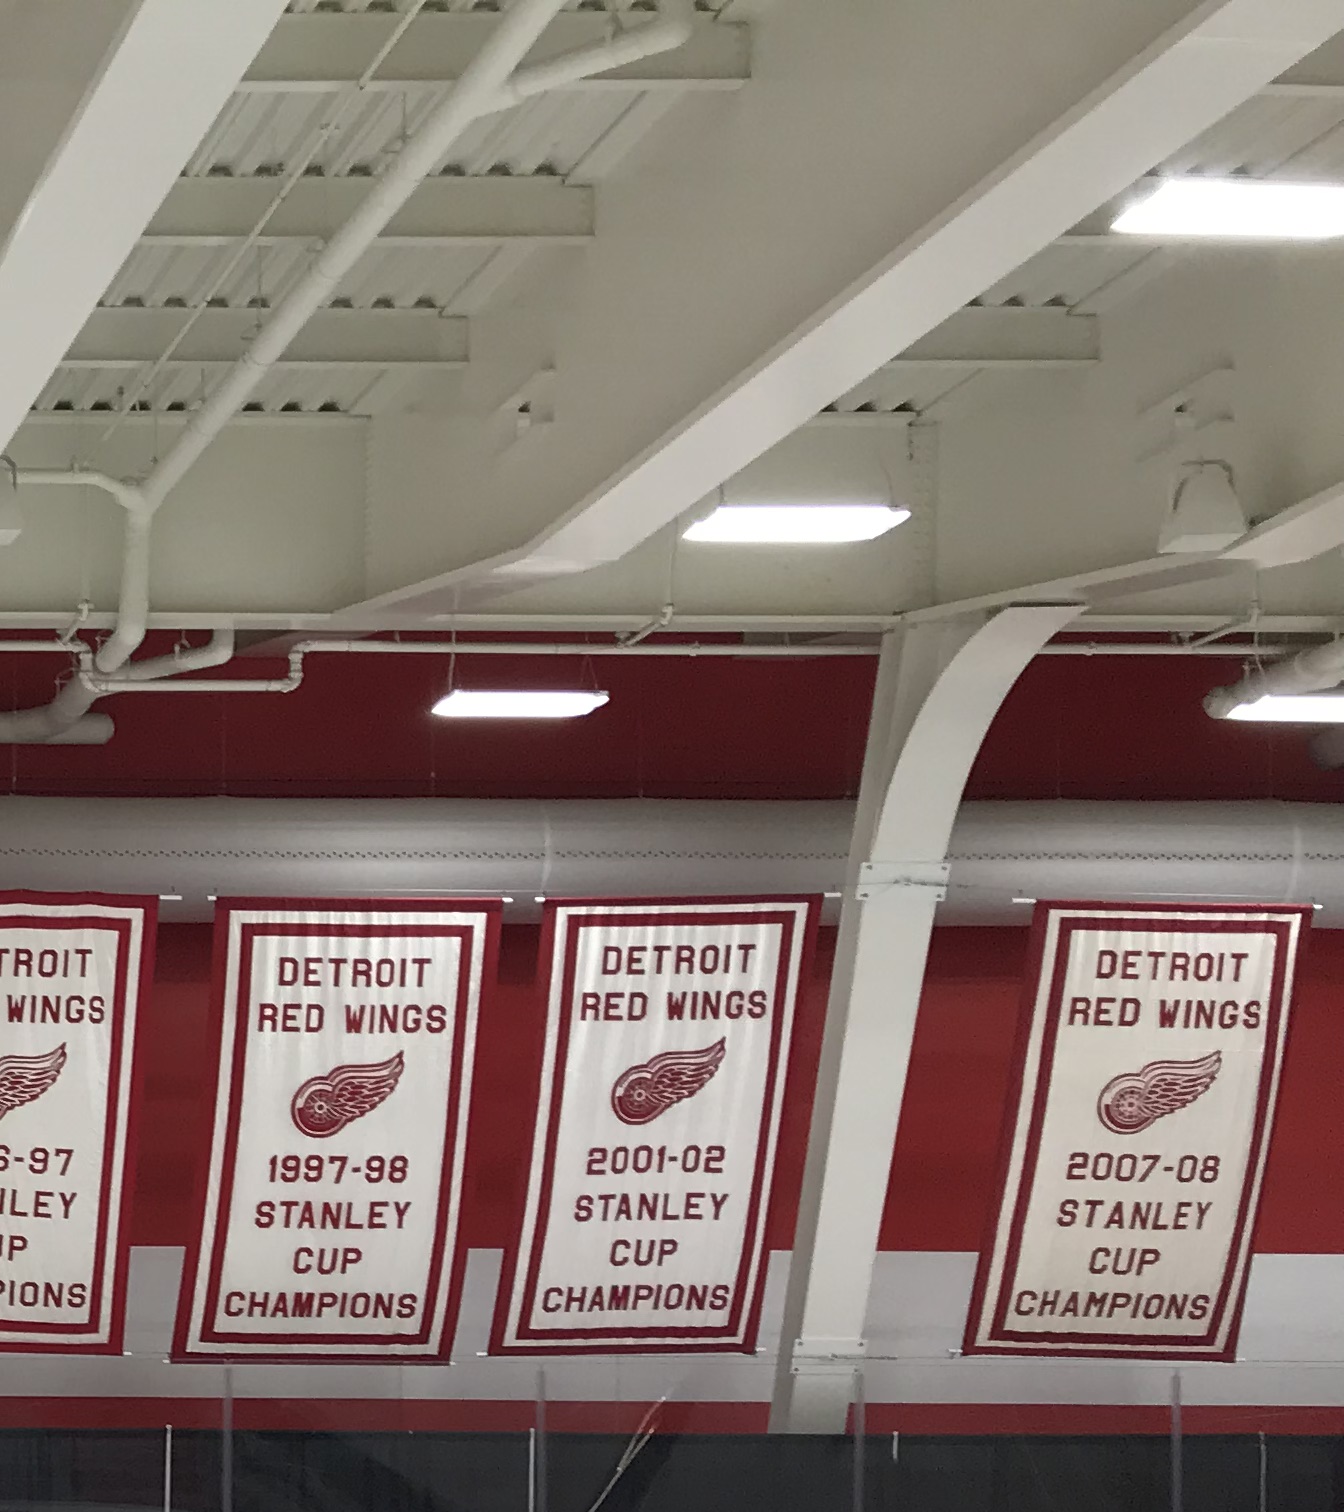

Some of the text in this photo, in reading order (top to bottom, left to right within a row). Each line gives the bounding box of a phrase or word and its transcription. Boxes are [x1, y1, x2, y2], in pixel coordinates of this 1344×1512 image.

[277, 956, 433, 988] DETROIT
[601, 943, 757, 976] DETROIT
[1095, 949, 1249, 983] DETROIT
[6, 994, 105, 1025] WINGS
[257, 1002, 447, 1034] RED WINGS
[580, 990, 767, 1022] RED WINGS
[1067, 996, 1262, 1030] RED WINGS
[269, 1154, 409, 1185] 1997-98
[585, 1144, 726, 1176] 2001-02
[1065, 1151, 1221, 1184] 2007-08
[254, 1200, 412, 1230] STANLEY
[573, 1192, 729, 1223] STANLEY
[1056, 1198, 1213, 1231] STANLEY
[292, 1246, 363, 1276] CUP
[609, 1238, 679, 1267] CUP
[1088, 1246, 1162, 1277] CUP
[223, 1291, 418, 1319] CHAMPIONS
[541, 1283, 730, 1314] CHAMPIONS
[1014, 1289, 1211, 1321] CHAMPIONS
